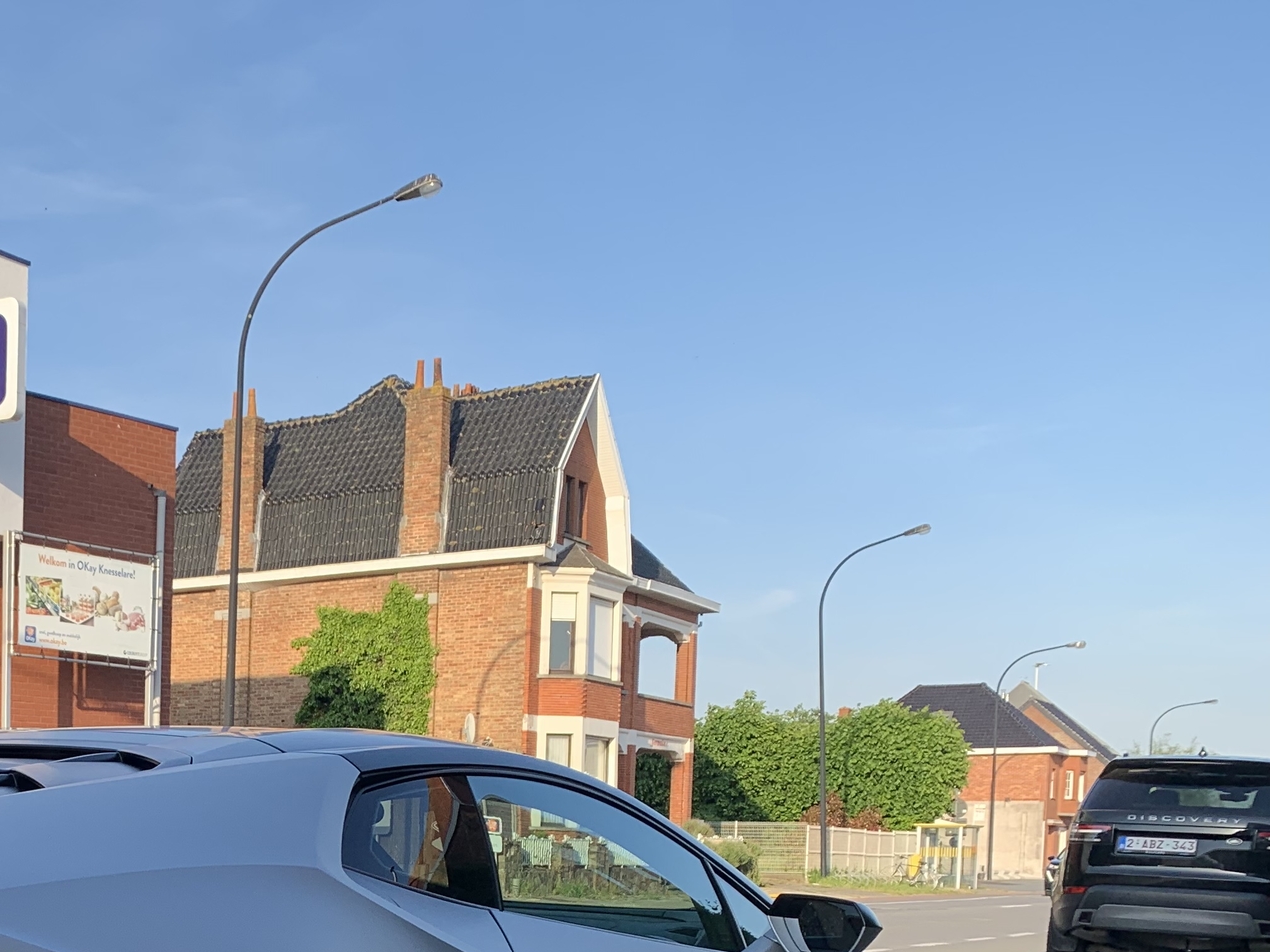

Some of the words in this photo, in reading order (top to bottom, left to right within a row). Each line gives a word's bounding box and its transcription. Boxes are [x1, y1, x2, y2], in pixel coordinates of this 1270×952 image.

[38, 554, 67, 567] Welkom
[68, 559, 75, 569] in
[77, 561, 96, 576] OKay
[99, 564, 135, 579] Knesselare!
[1127, 814, 1242, 824] DISCOVERY
[1126, 838, 1196, 851] 2-ABZ-343
